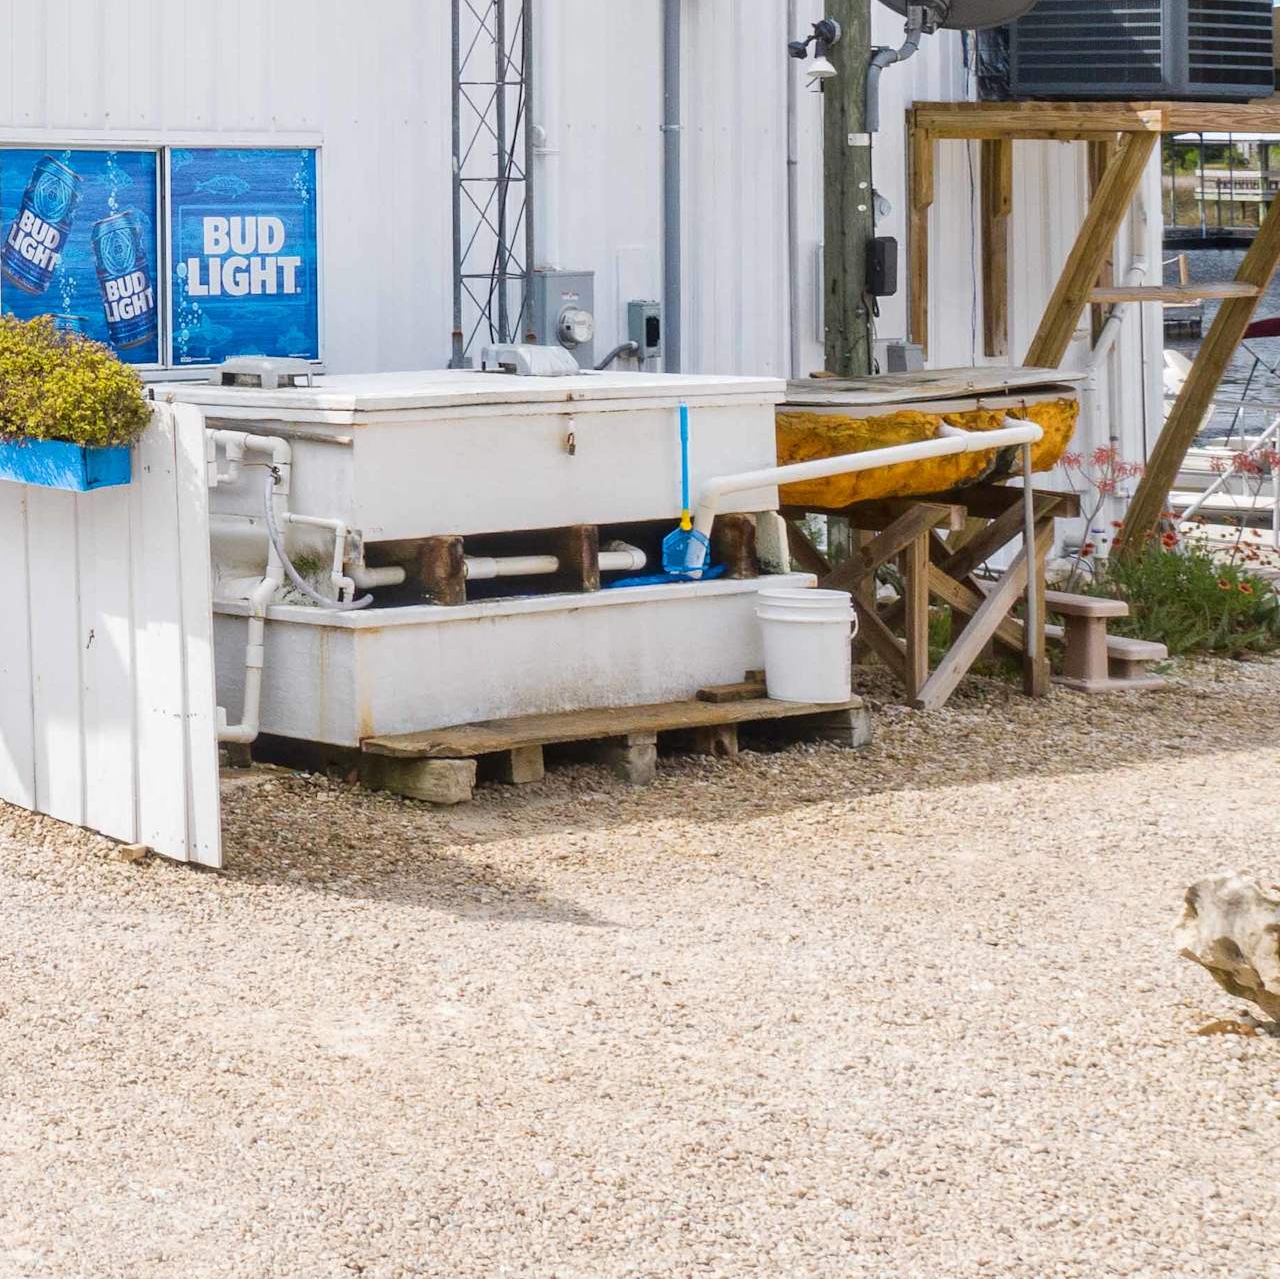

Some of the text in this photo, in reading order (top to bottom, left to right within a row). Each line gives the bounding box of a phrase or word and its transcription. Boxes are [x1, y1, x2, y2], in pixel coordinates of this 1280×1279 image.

[7, 224, 61, 272] LIGHT
[19, 209, 61, 250] BUD
[203, 216, 285, 255] BUD
[104, 271, 146, 302] BUD
[104, 288, 155, 323] LIGHT
